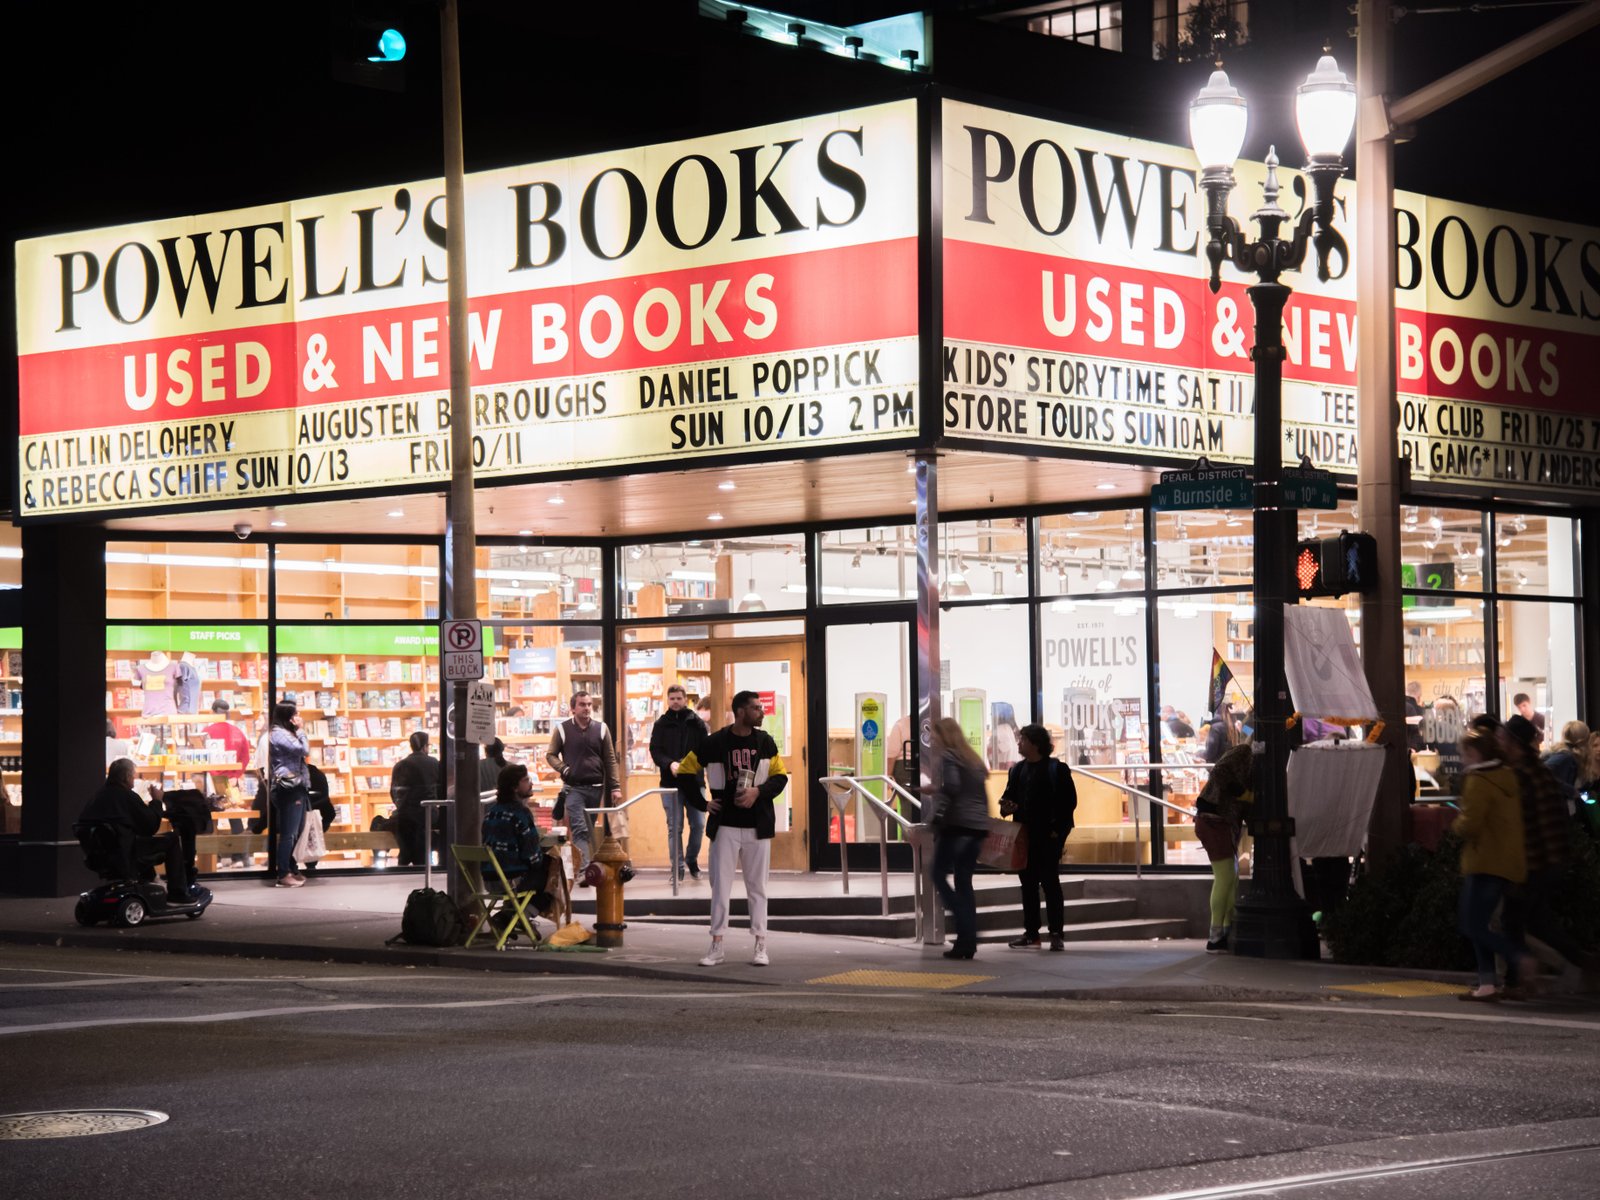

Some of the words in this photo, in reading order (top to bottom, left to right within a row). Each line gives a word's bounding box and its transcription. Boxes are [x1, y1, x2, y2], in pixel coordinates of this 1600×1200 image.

[507, 126, 867, 273] BOOKS
[124, 341, 272, 412] USED
[303, 333, 339, 394] &
[362, 309, 502, 385] NEW
[531, 273, 778, 364] BOOKS
[1042, 269, 1186, 350] USED
[1211, 296, 1249, 359] &
[1400, 321, 1560, 397] BOOKS
[639, 366, 738, 410] DANIEL
[753, 349, 882, 397] POPPICK
[944, 345, 1015, 388] KIDS'
[1027, 356, 1166, 405] STORYTIME
[1177, 373, 1220, 411] SAT
[298, 401, 419, 446] AUGUSTEN
[437, 380, 607, 430] BRROUGHS
[670, 411, 724, 450] SUN
[744, 400, 824, 443] 10/13
[944, 391, 1028, 435] STORE
[1037, 401, 1114, 442] TOURS
[1436, 404, 1485, 439] CLUB
[1500, 411, 1530, 444] FRI
[1536, 415, 1586, 449] 10/25
[25, 434, 111, 471] CAITLIN
[473, 431, 522, 468] 0/11
[24, 479, 37, 509] &
[42, 470, 142, 508] REBECCA
[149, 460, 228, 498] SCHIFF
[236, 456, 279, 491] SUN
[288, 448, 349, 486] 10/13
[1162, 473, 1195, 483] PEARL
[1198, 469, 1245, 481] DISTRICT
[1158, 495, 1167, 505] W
[1173, 485, 1233, 505] Burnside
[1284, 489, 1296, 501] NW
[190, 630, 215, 641] STAFF
[216, 631, 241, 641] PICKS
[394, 635, 421, 645] AWARD
[1045, 636, 1138, 668] POWELL'S
[448, 665, 479, 676] BLOCK
[452, 654, 475, 664] THIS
[1098, 673, 1112, 693] of
